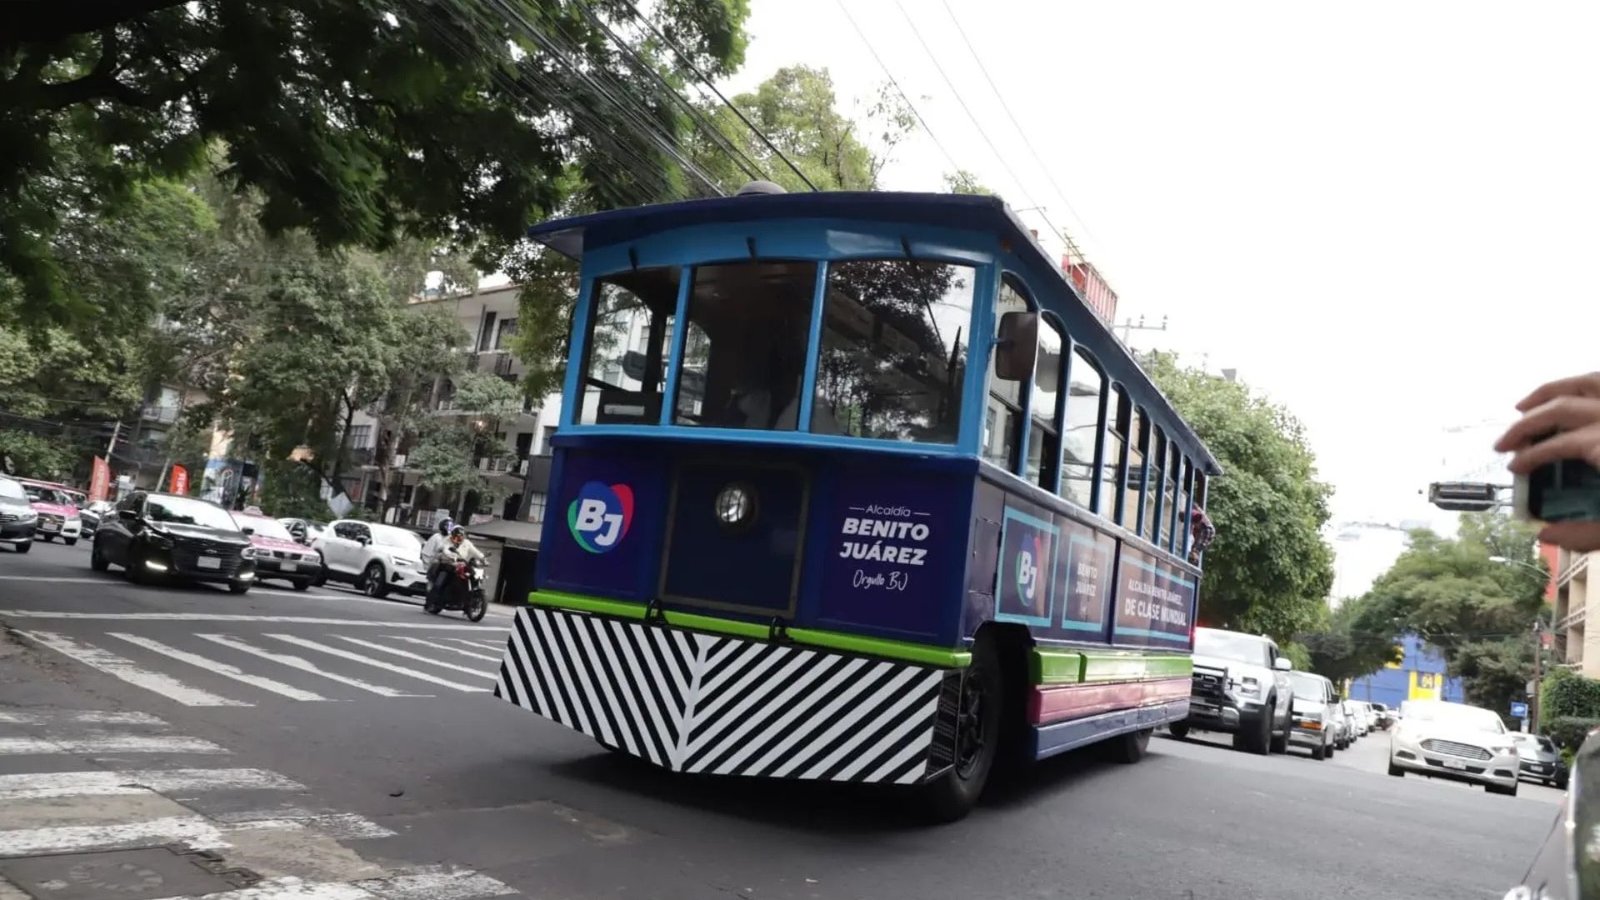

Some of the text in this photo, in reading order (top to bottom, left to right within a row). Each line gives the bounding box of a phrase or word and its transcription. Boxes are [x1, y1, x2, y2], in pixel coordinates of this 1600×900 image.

[574, 498, 624, 546] BJ
[865, 504, 911, 517] Alcaldía
[842, 517, 930, 541] BENITO
[839, 540, 928, 566] JUÁREZ
[853, 569, 909, 591] Orgullo BJ
[1019, 551, 1037, 599] BJ
[1077, 562, 1098, 580] BENITO
[1075, 581, 1097, 597] JUÁREZ
[1124, 597, 1186, 626] DE CLASE MUNDIAL
